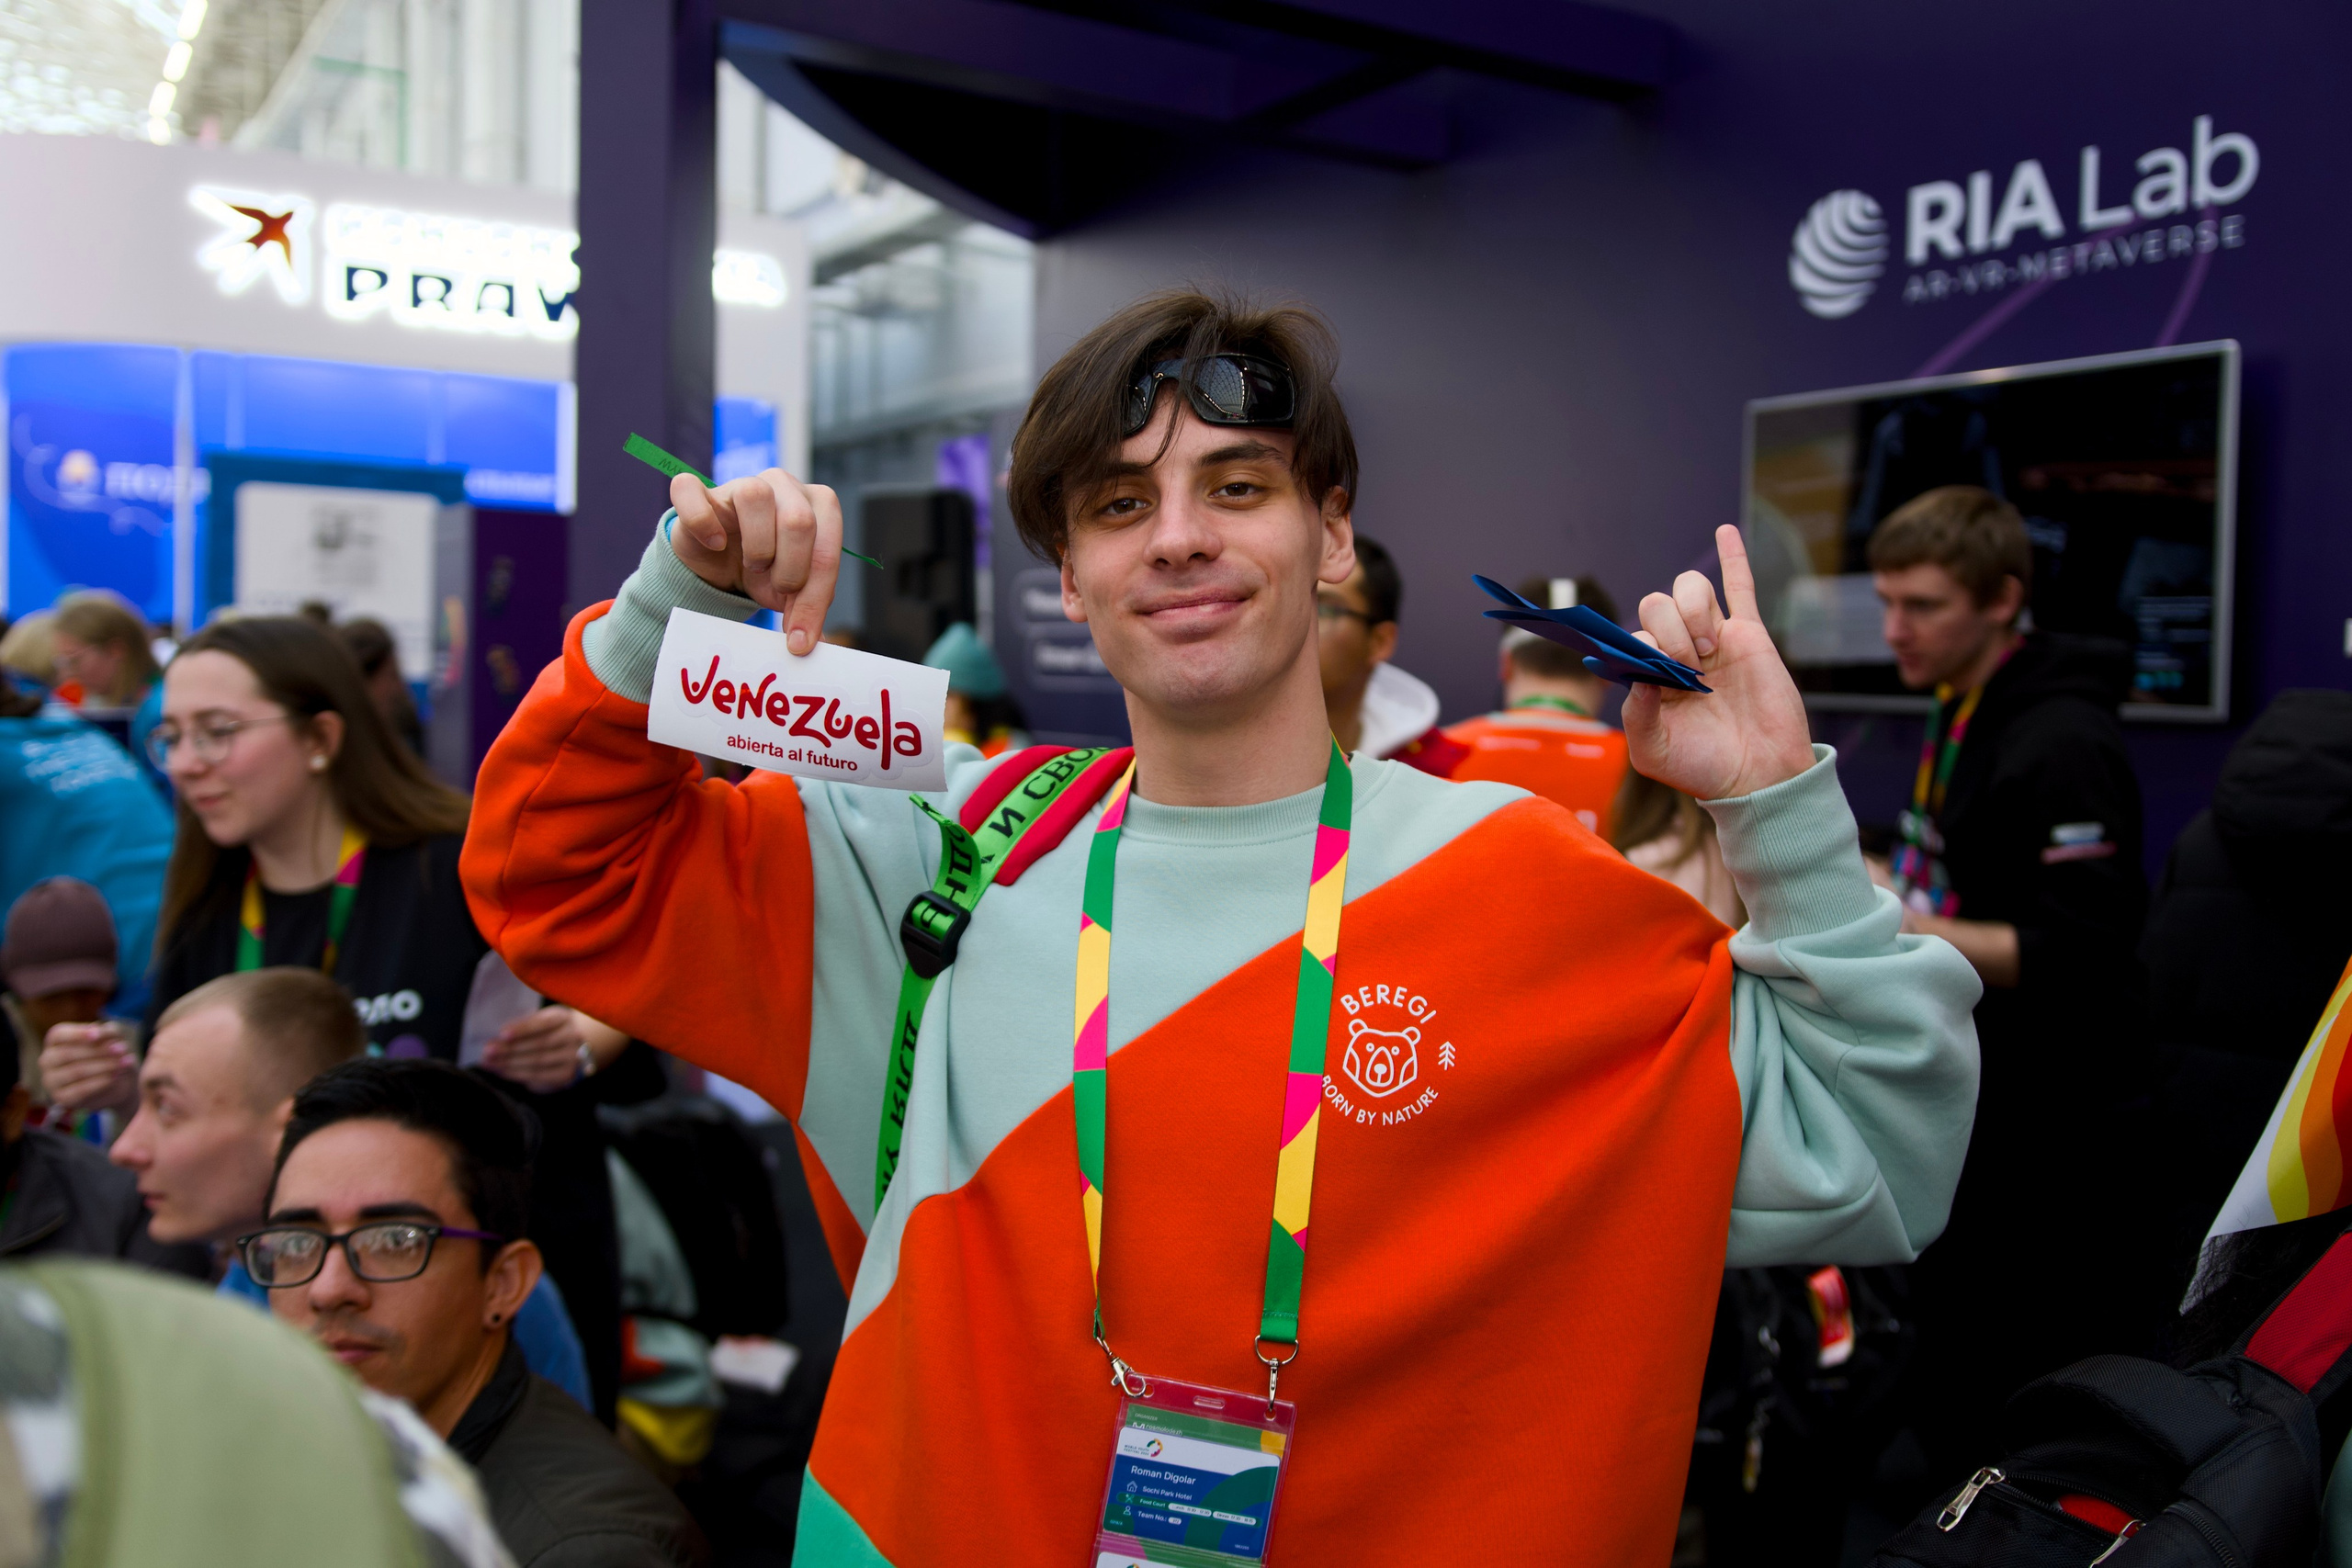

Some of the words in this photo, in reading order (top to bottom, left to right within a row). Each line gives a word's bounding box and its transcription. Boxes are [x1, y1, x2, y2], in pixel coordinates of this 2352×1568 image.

[1905, 157, 2066, 269] RIA
[2078, 112, 2261, 233] Lab
[727, 735, 784, 759] abierta
[787, 747, 803, 762] al
[807, 750, 858, 772] futuro
[1023, 747, 1114, 800] СВО
[1340, 984, 1437, 1024] BEREGI
[1321, 1074, 1354, 1117] BORN
[1356, 1109, 1377, 1126] BY
[1382, 1086, 1439, 1126] NATURE
[1131, 1465, 1162, 1479] Roman
[1164, 1472, 1196, 1484] Digolar
[1142, 1485, 1159, 1495] Sochi
[1160, 1489, 1175, 1497] Park
[1176, 1492, 1193, 1501] Hotel
[1137, 1510, 1154, 1519] Team
